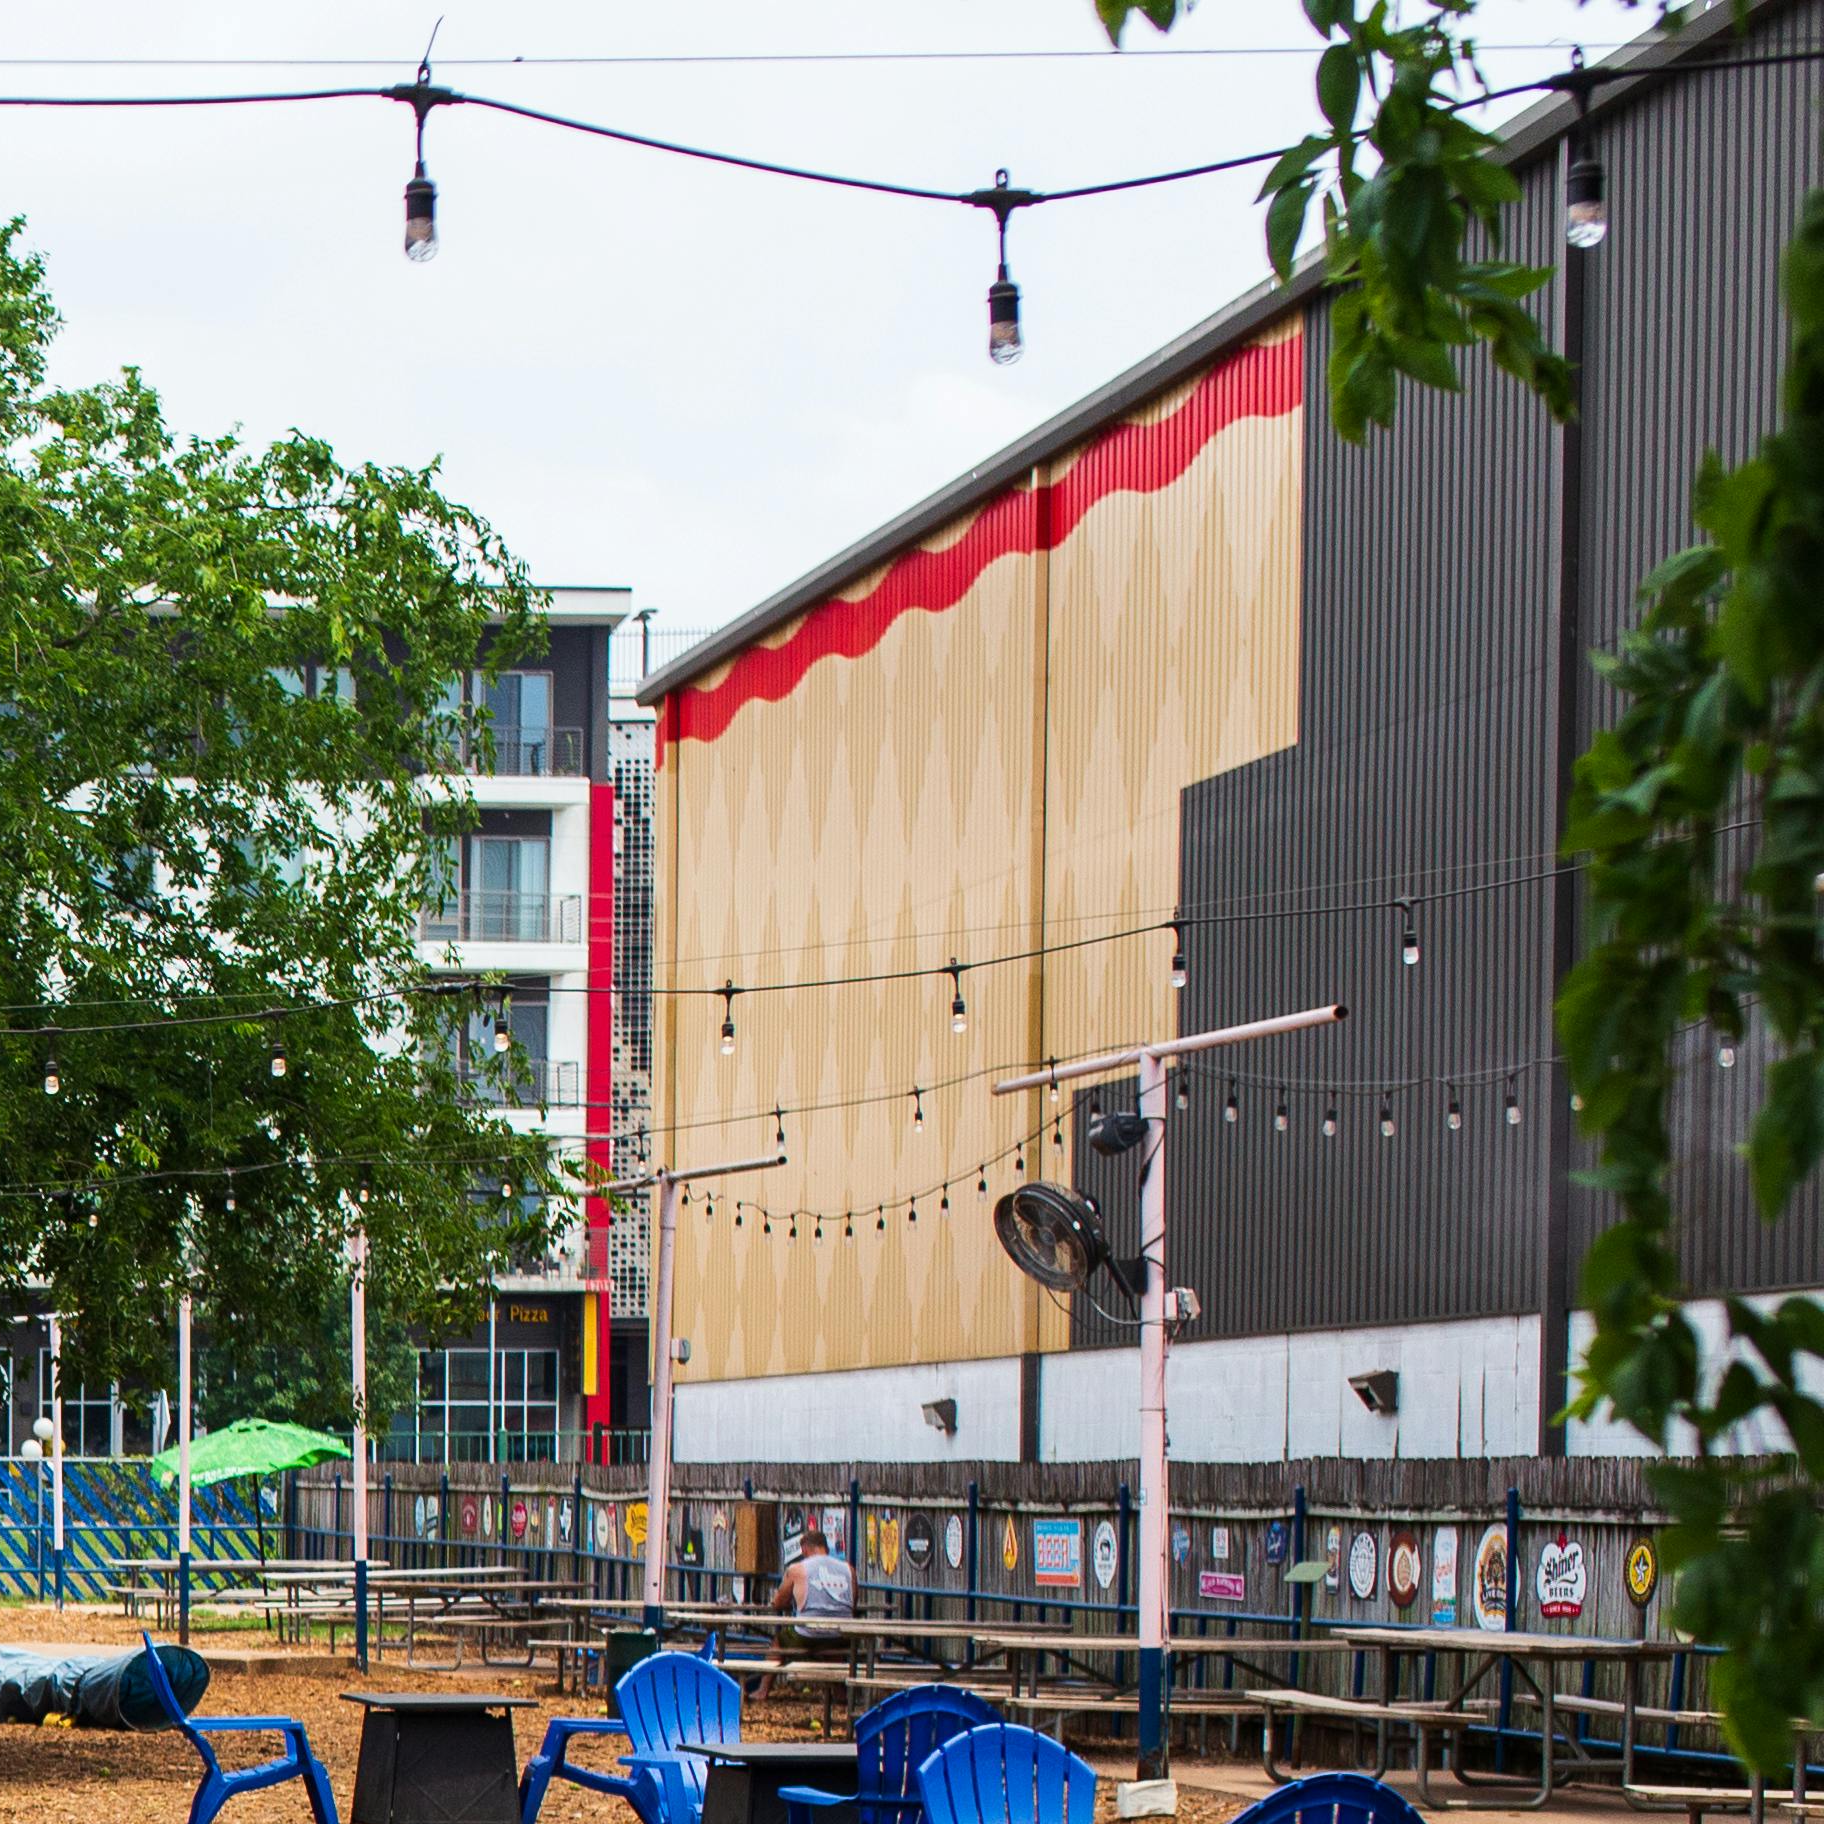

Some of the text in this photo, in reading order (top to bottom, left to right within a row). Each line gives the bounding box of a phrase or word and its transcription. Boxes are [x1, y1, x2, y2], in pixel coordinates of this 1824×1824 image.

[510, 1304, 549, 1323] Pizza
[1545, 1550, 1580, 1583] Shiner
[1549, 1586, 1574, 1598] BEERS
